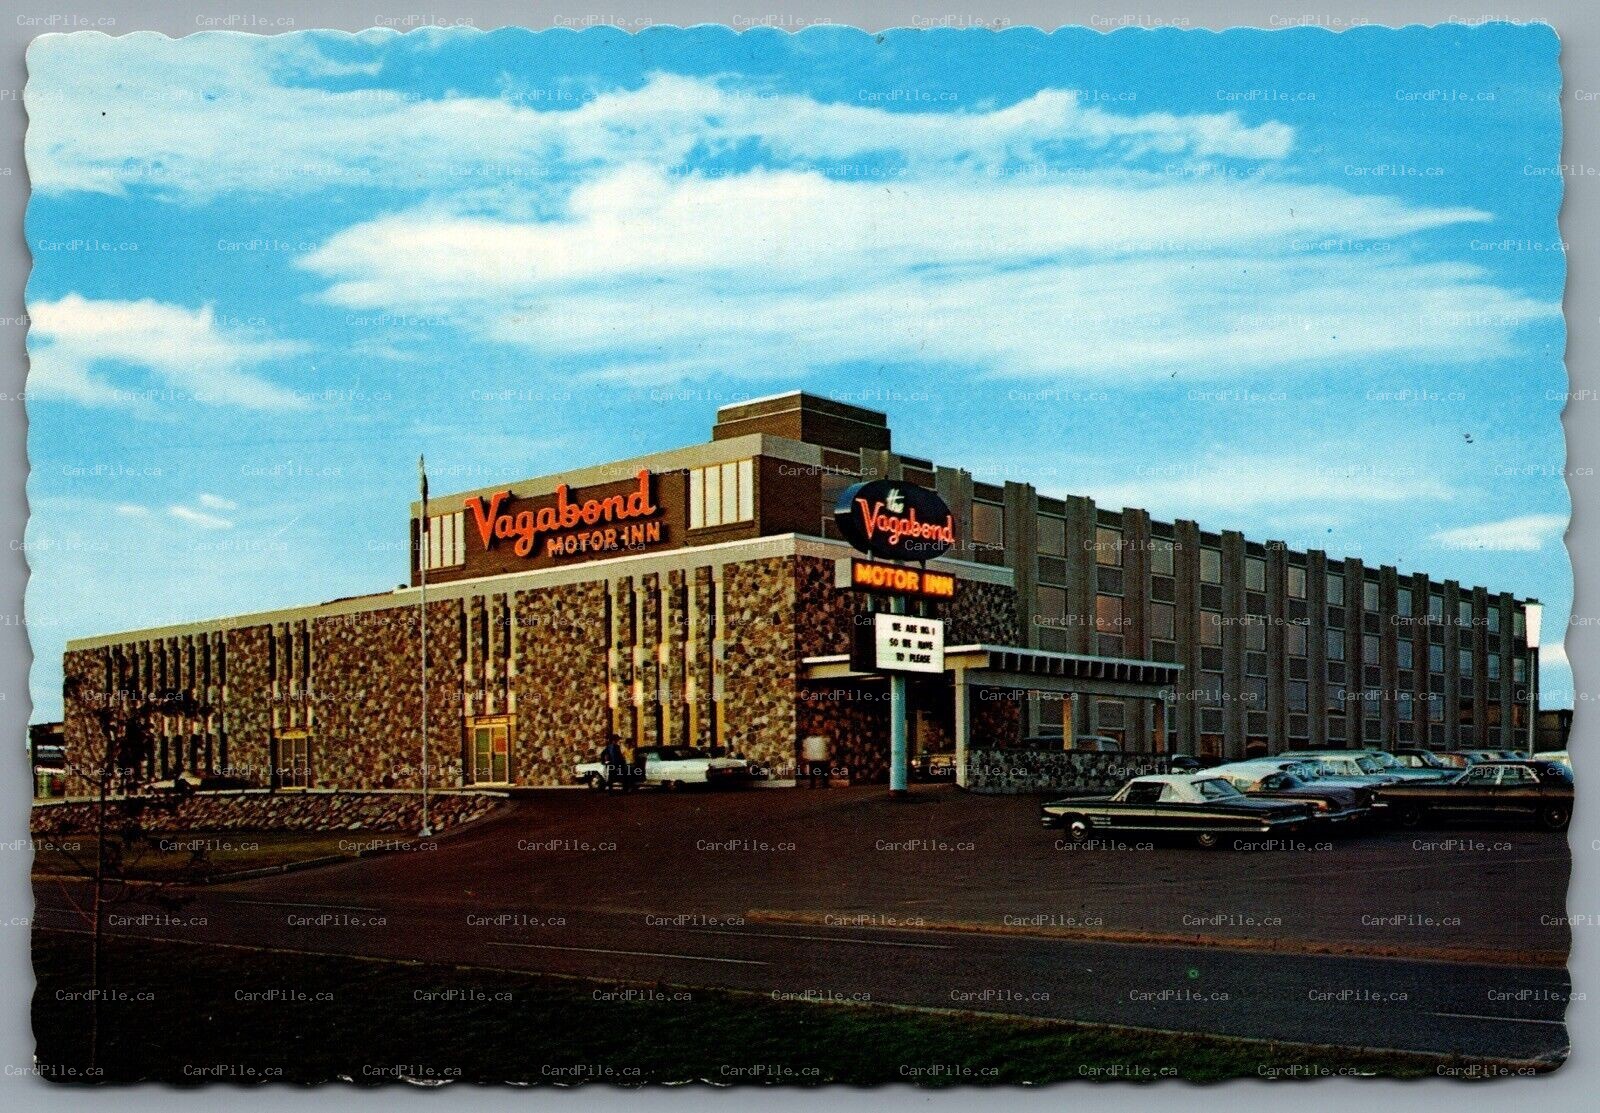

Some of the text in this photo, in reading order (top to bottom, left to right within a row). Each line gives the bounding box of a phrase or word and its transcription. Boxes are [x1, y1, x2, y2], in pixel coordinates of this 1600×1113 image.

[464, 469, 656, 557] Vagabond
[855, 498, 955, 545] Vagabond
[855, 563, 954, 596] MOTOR INN
[889, 637, 899, 647] SO
[909, 653, 931, 664] PLEASE
